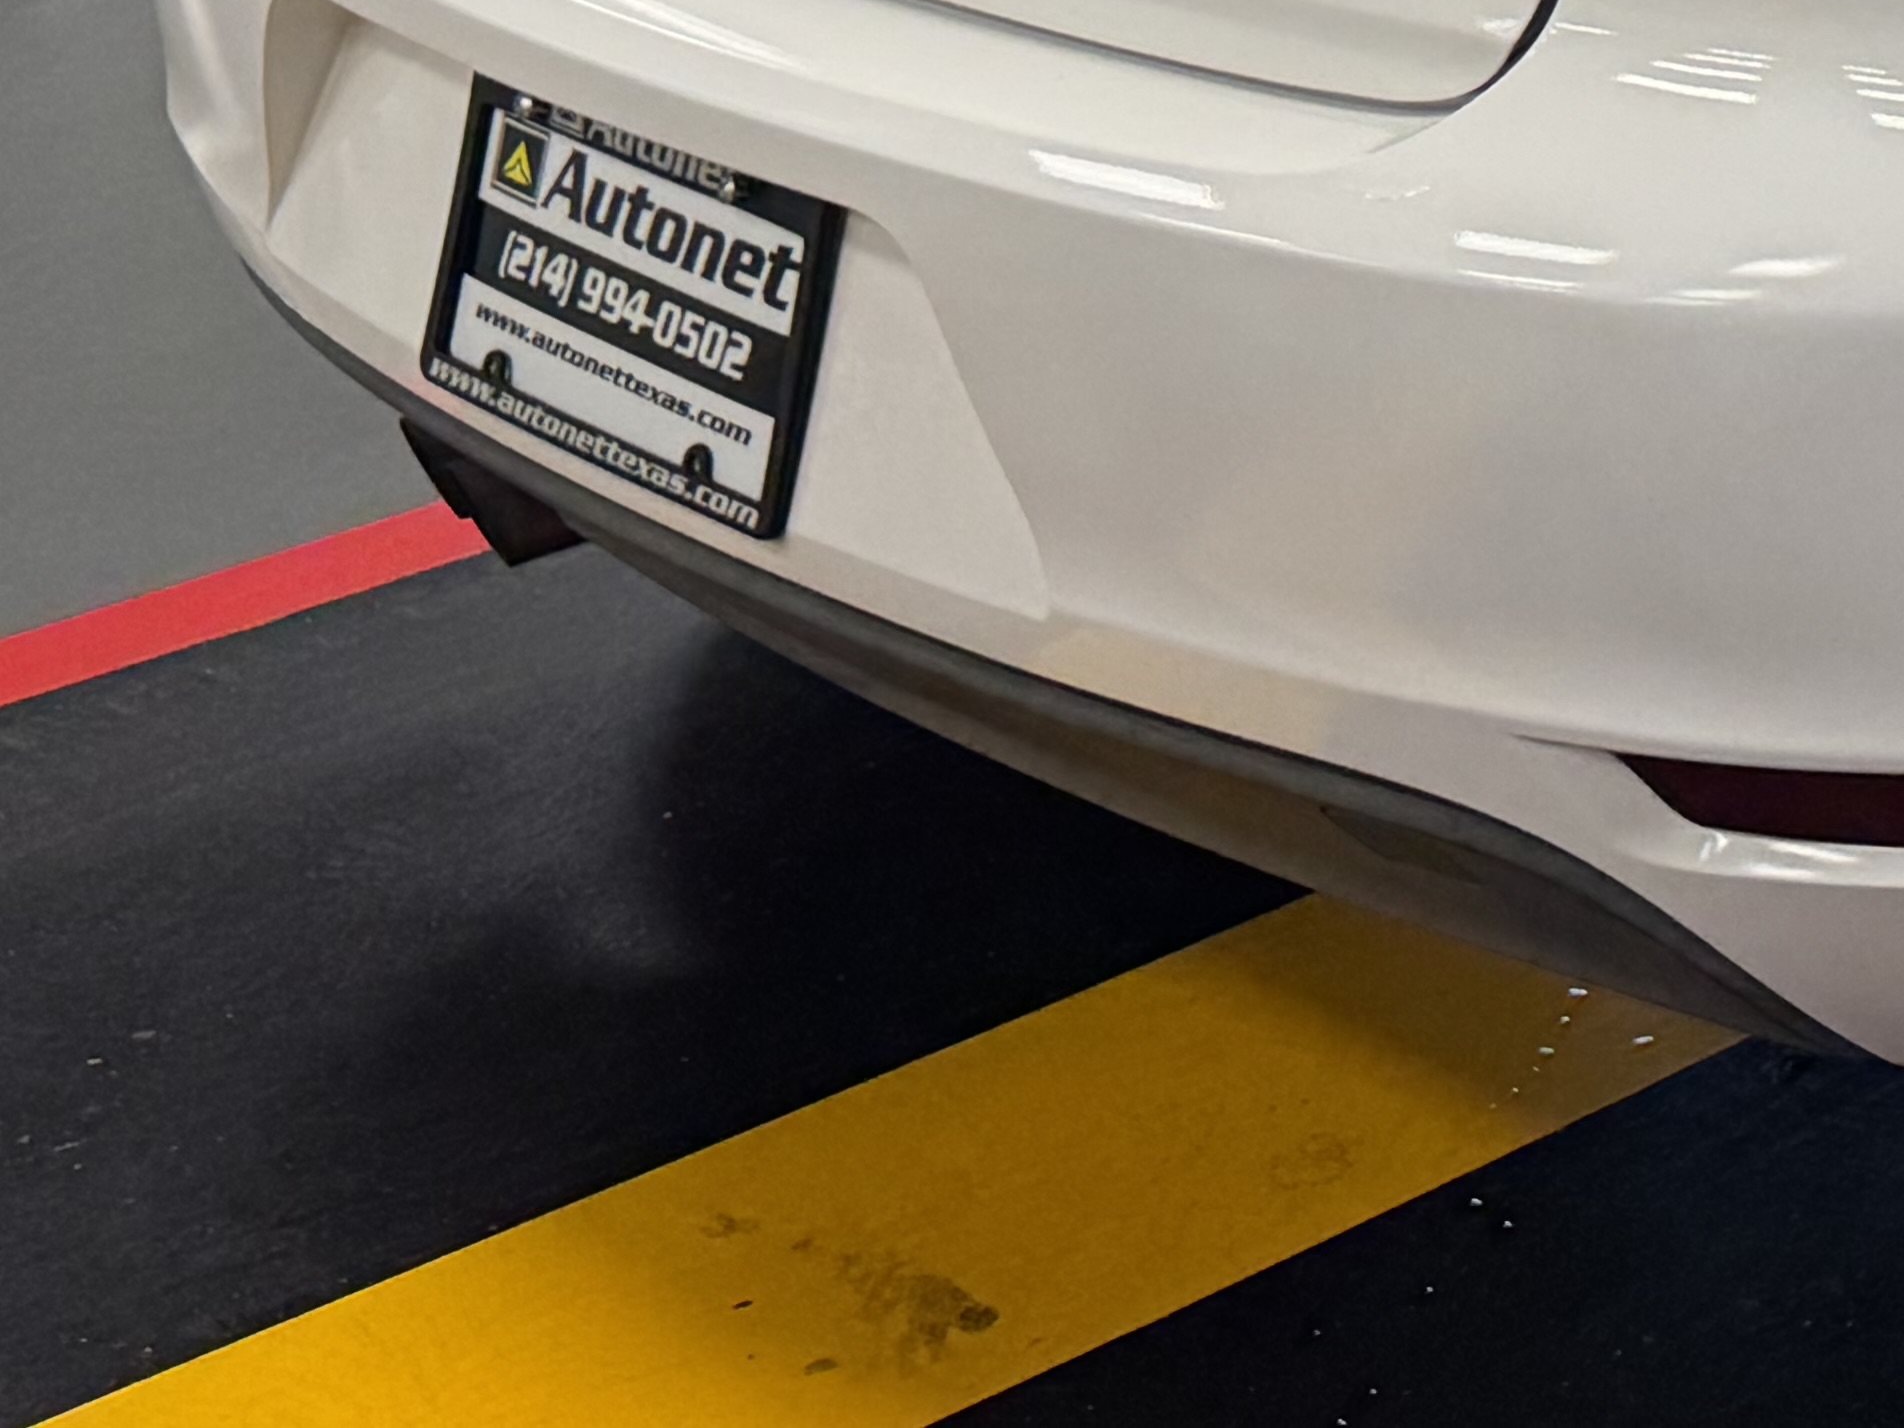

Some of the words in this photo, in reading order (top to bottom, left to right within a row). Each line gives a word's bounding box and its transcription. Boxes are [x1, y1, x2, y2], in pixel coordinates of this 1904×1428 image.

[498, 230, 578, 307] (214)
[577, 266, 752, 381] 994-0502
[541, 146, 804, 312] Autonet
[428, 357, 760, 530] www.autonettexas.com
[475, 301, 752, 445] www.autonettexas.com
